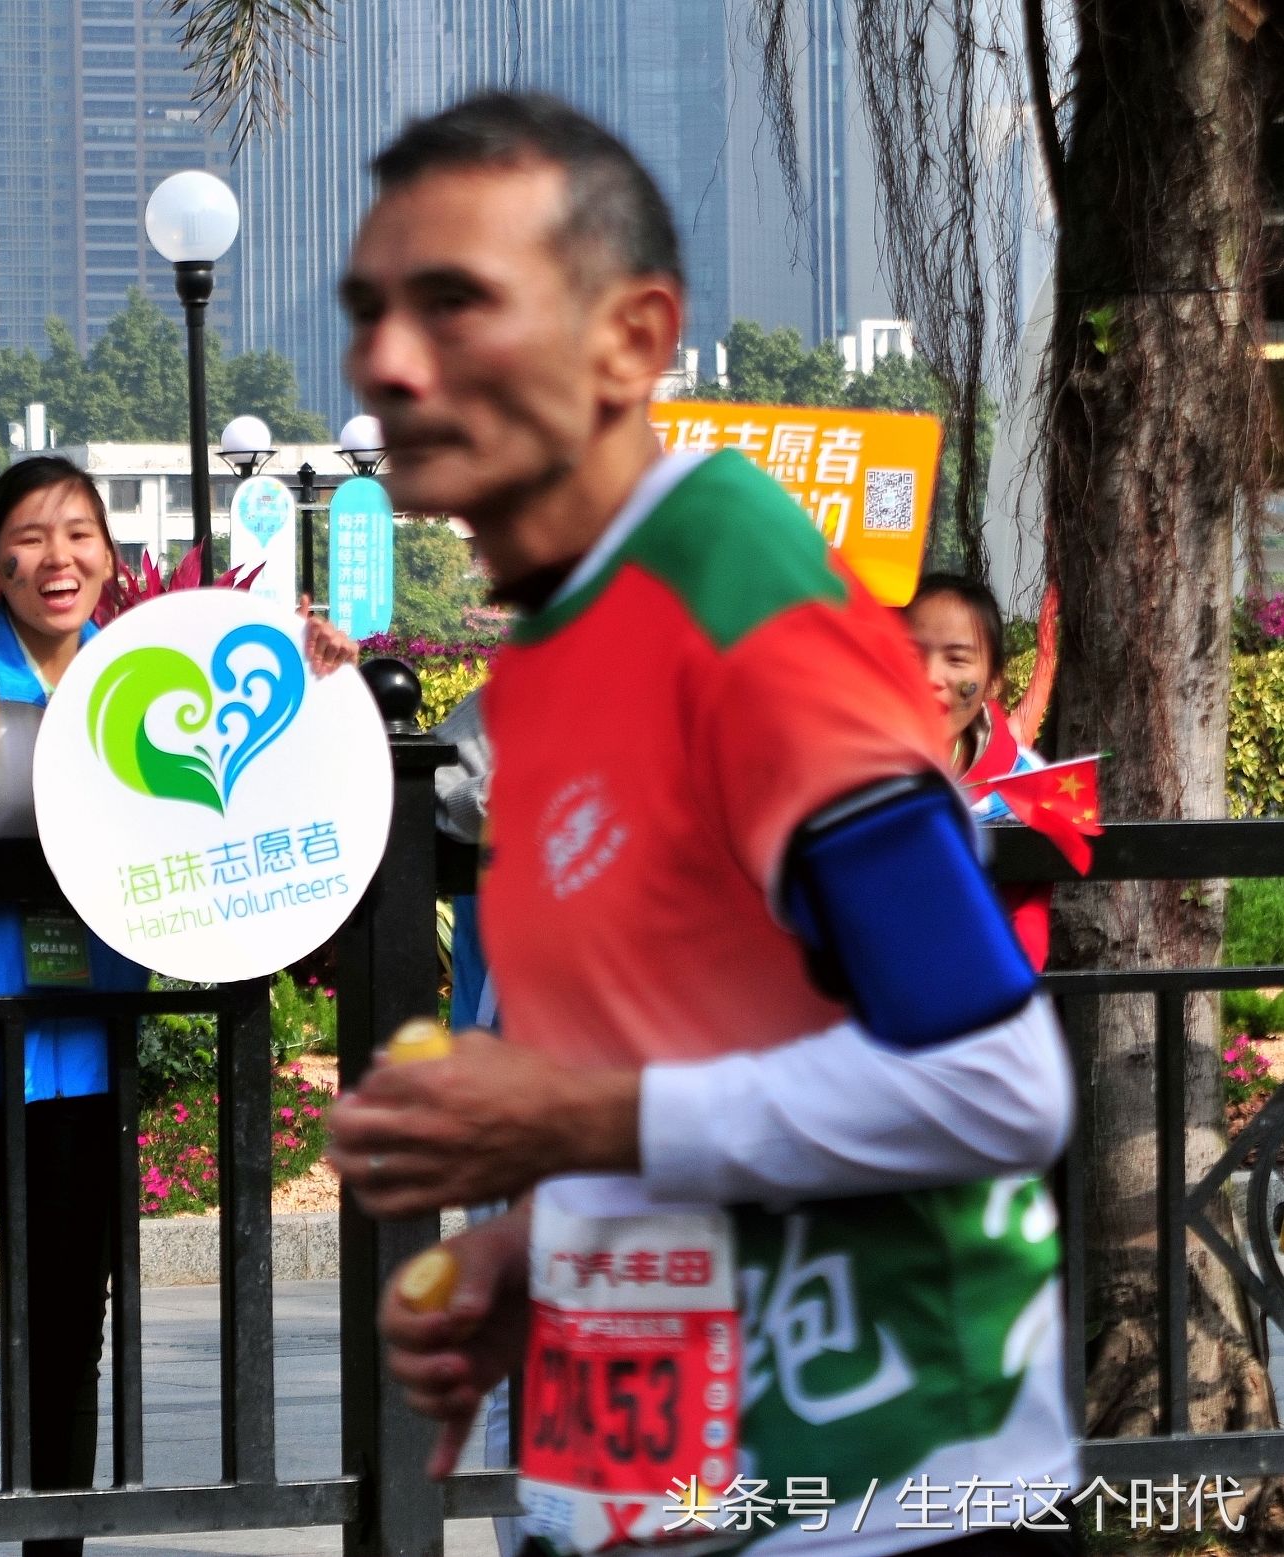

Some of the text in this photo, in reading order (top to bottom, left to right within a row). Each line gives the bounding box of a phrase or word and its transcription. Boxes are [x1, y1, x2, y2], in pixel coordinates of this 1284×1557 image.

[650, 419, 863, 485] 珠愿者
[118, 821, 340, 906] 海珠志愿者
[126, 873, 349, 943] Haizhu Volunteers
